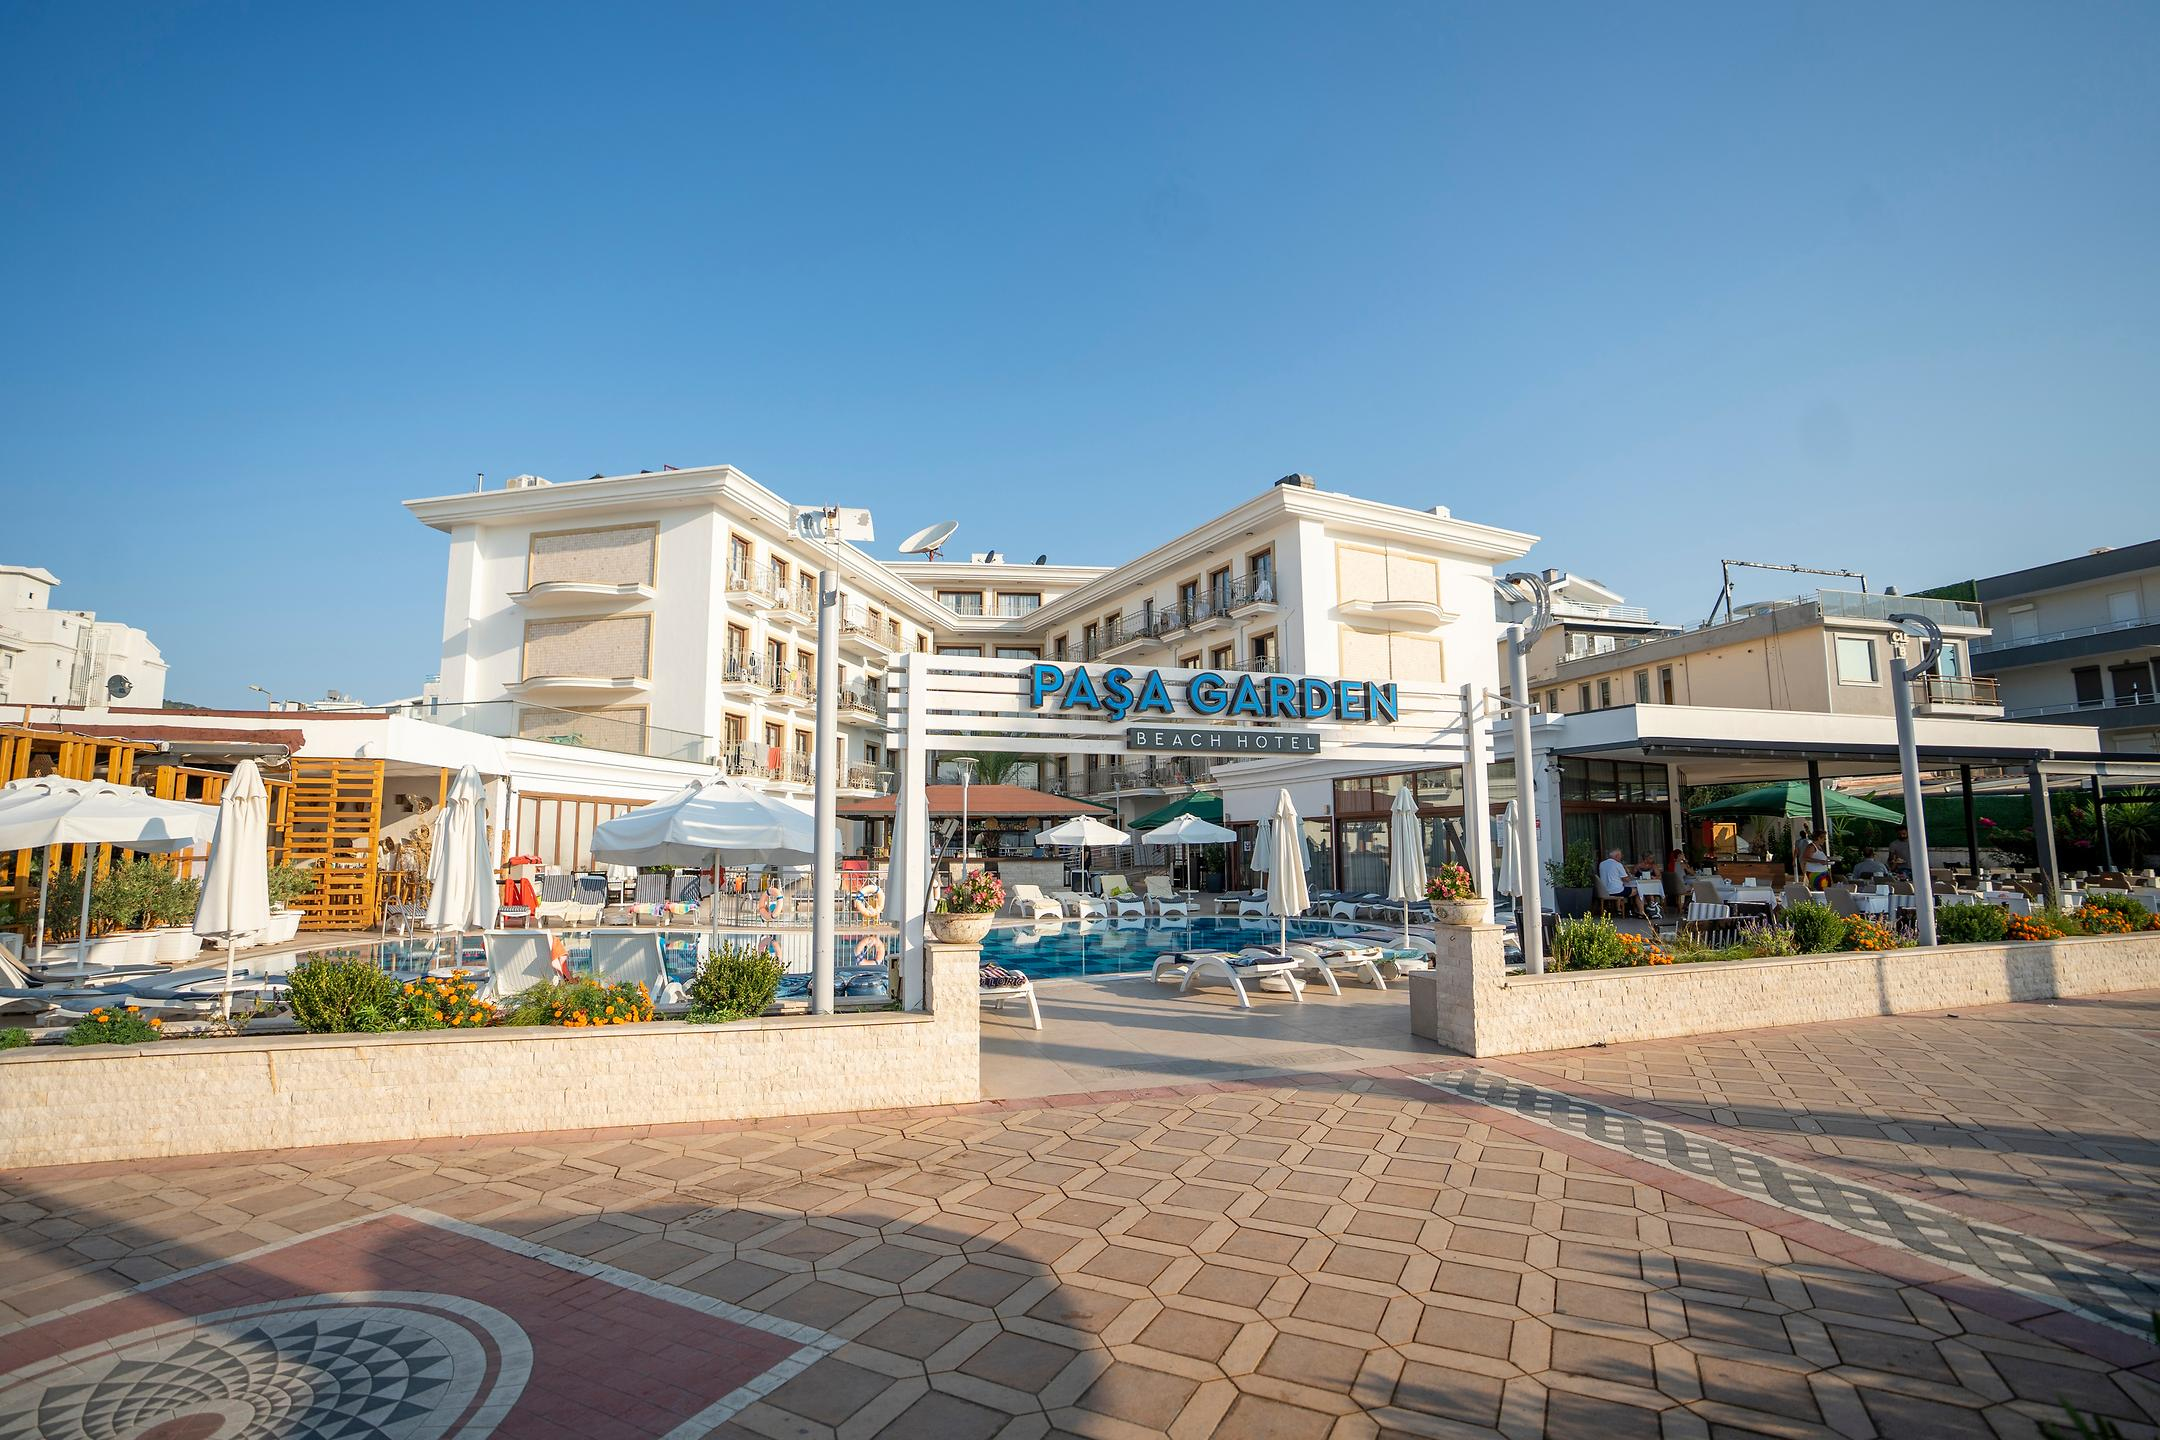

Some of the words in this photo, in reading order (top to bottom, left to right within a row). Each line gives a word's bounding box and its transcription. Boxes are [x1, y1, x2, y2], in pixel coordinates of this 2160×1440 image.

[1031, 664, 1176, 721] PAŞA
[1186, 672, 1398, 723] GARDEN
[1137, 732, 1221, 748] BEACH
[1237, 735, 1315, 750] HOTEL
